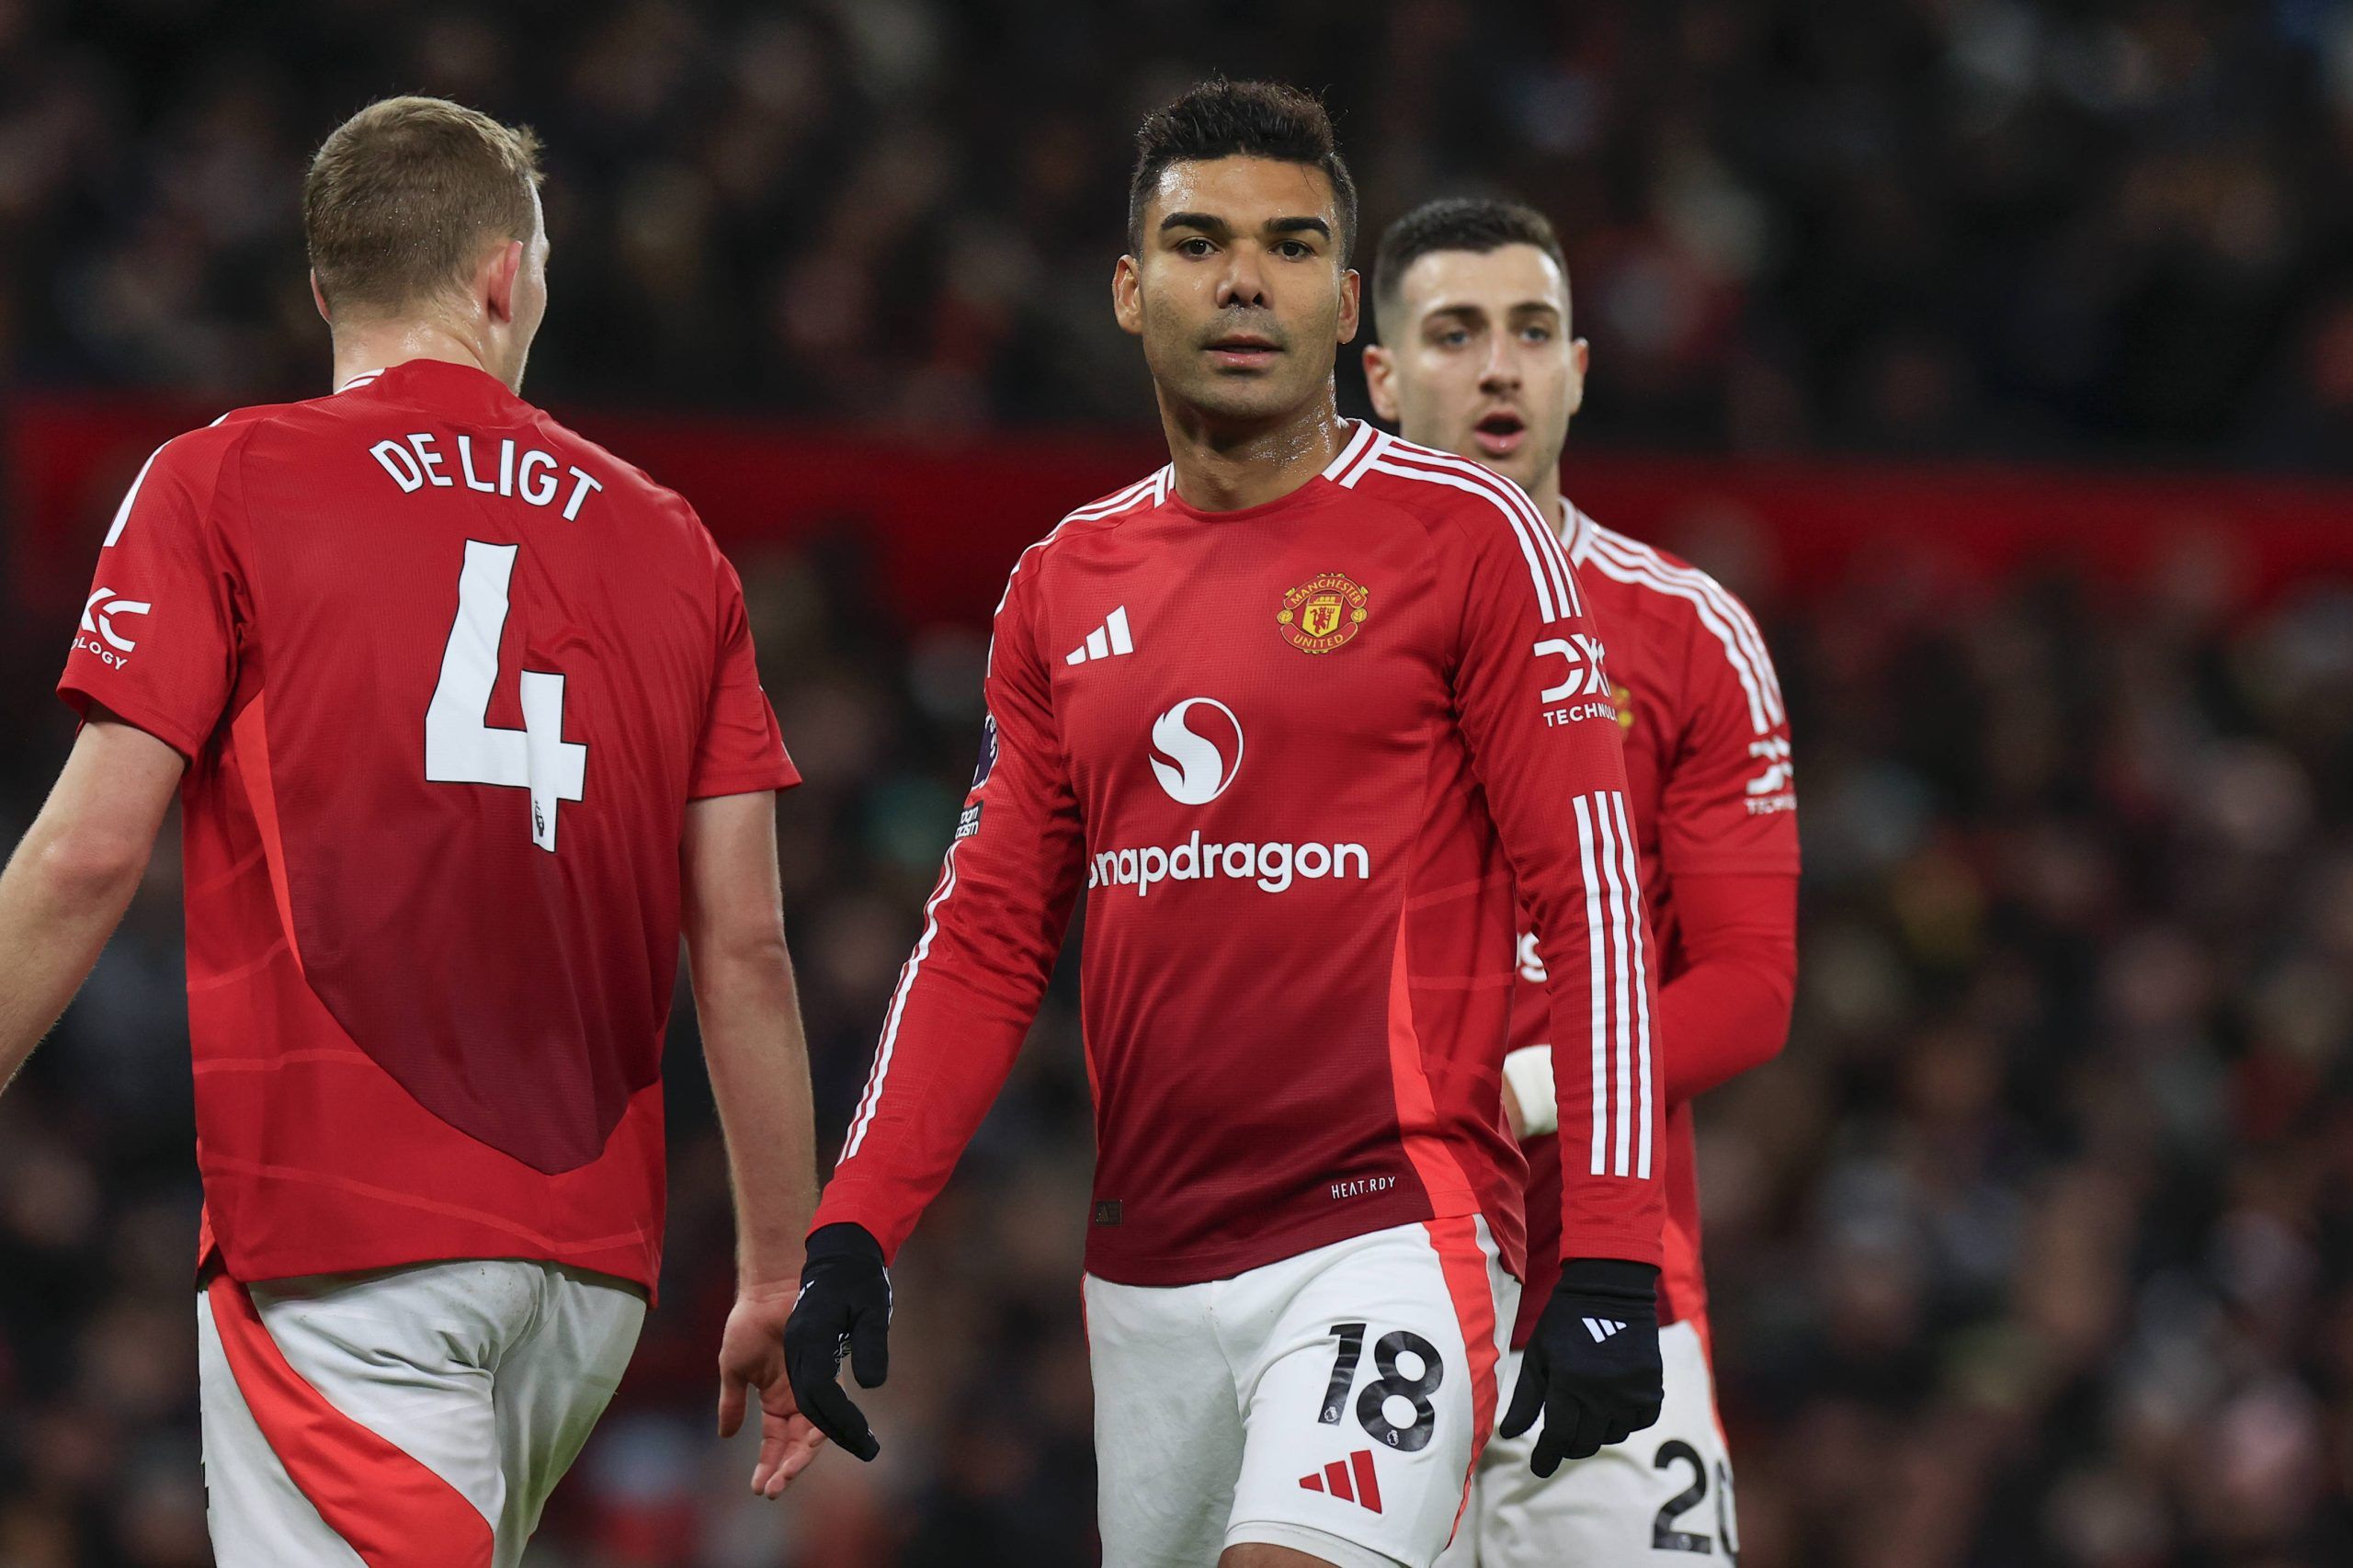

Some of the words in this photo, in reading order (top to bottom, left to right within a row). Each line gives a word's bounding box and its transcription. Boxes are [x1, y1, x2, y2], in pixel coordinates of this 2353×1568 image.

[369, 433, 454, 494] DE
[457, 435, 603, 522] LIGT
[1290, 579, 1361, 604] MANCHESTER
[1293, 633, 1344, 648] UNITED
[425, 538, 588, 854] 4
[1331, 1176, 1395, 1199] HEAT.RDY
[1317, 1324, 1444, 1452] 18
